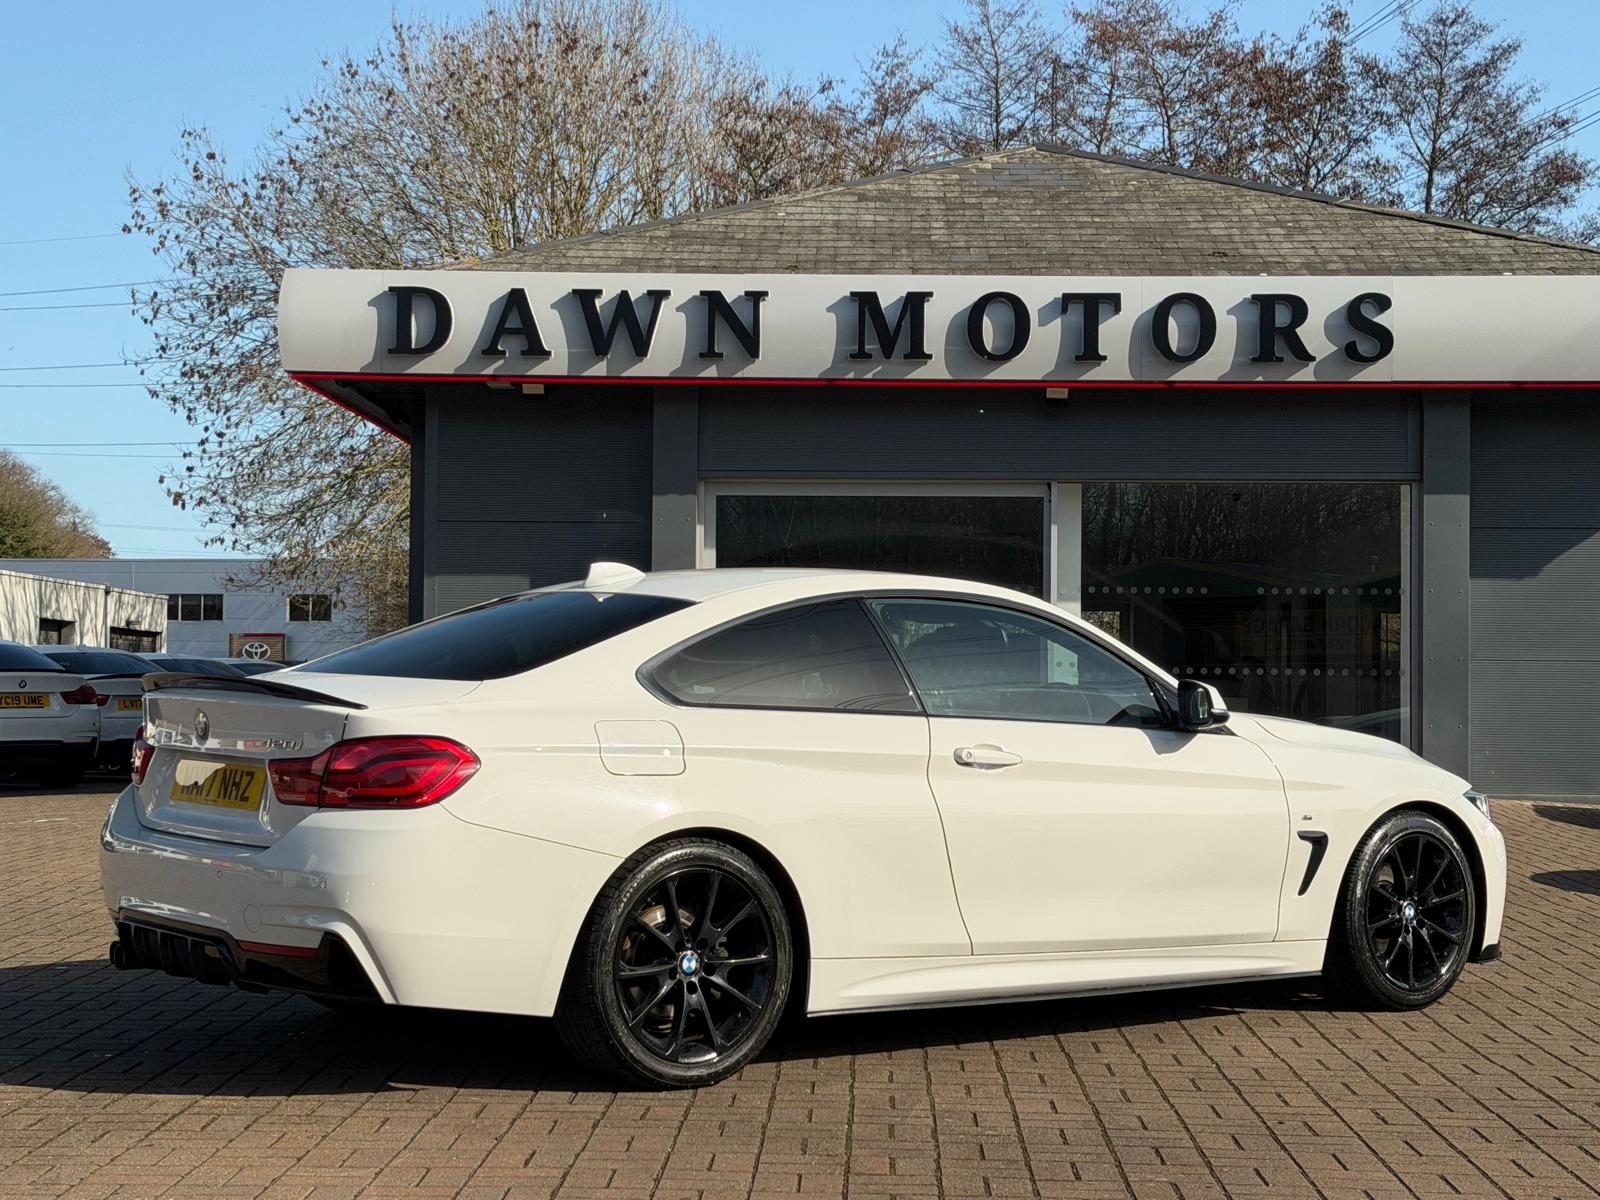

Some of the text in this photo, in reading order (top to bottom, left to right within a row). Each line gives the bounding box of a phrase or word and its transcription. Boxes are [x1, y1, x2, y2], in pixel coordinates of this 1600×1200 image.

[387, 285, 1395, 364] DAWN MOTORS
[216, 768, 256, 803] NHZ
